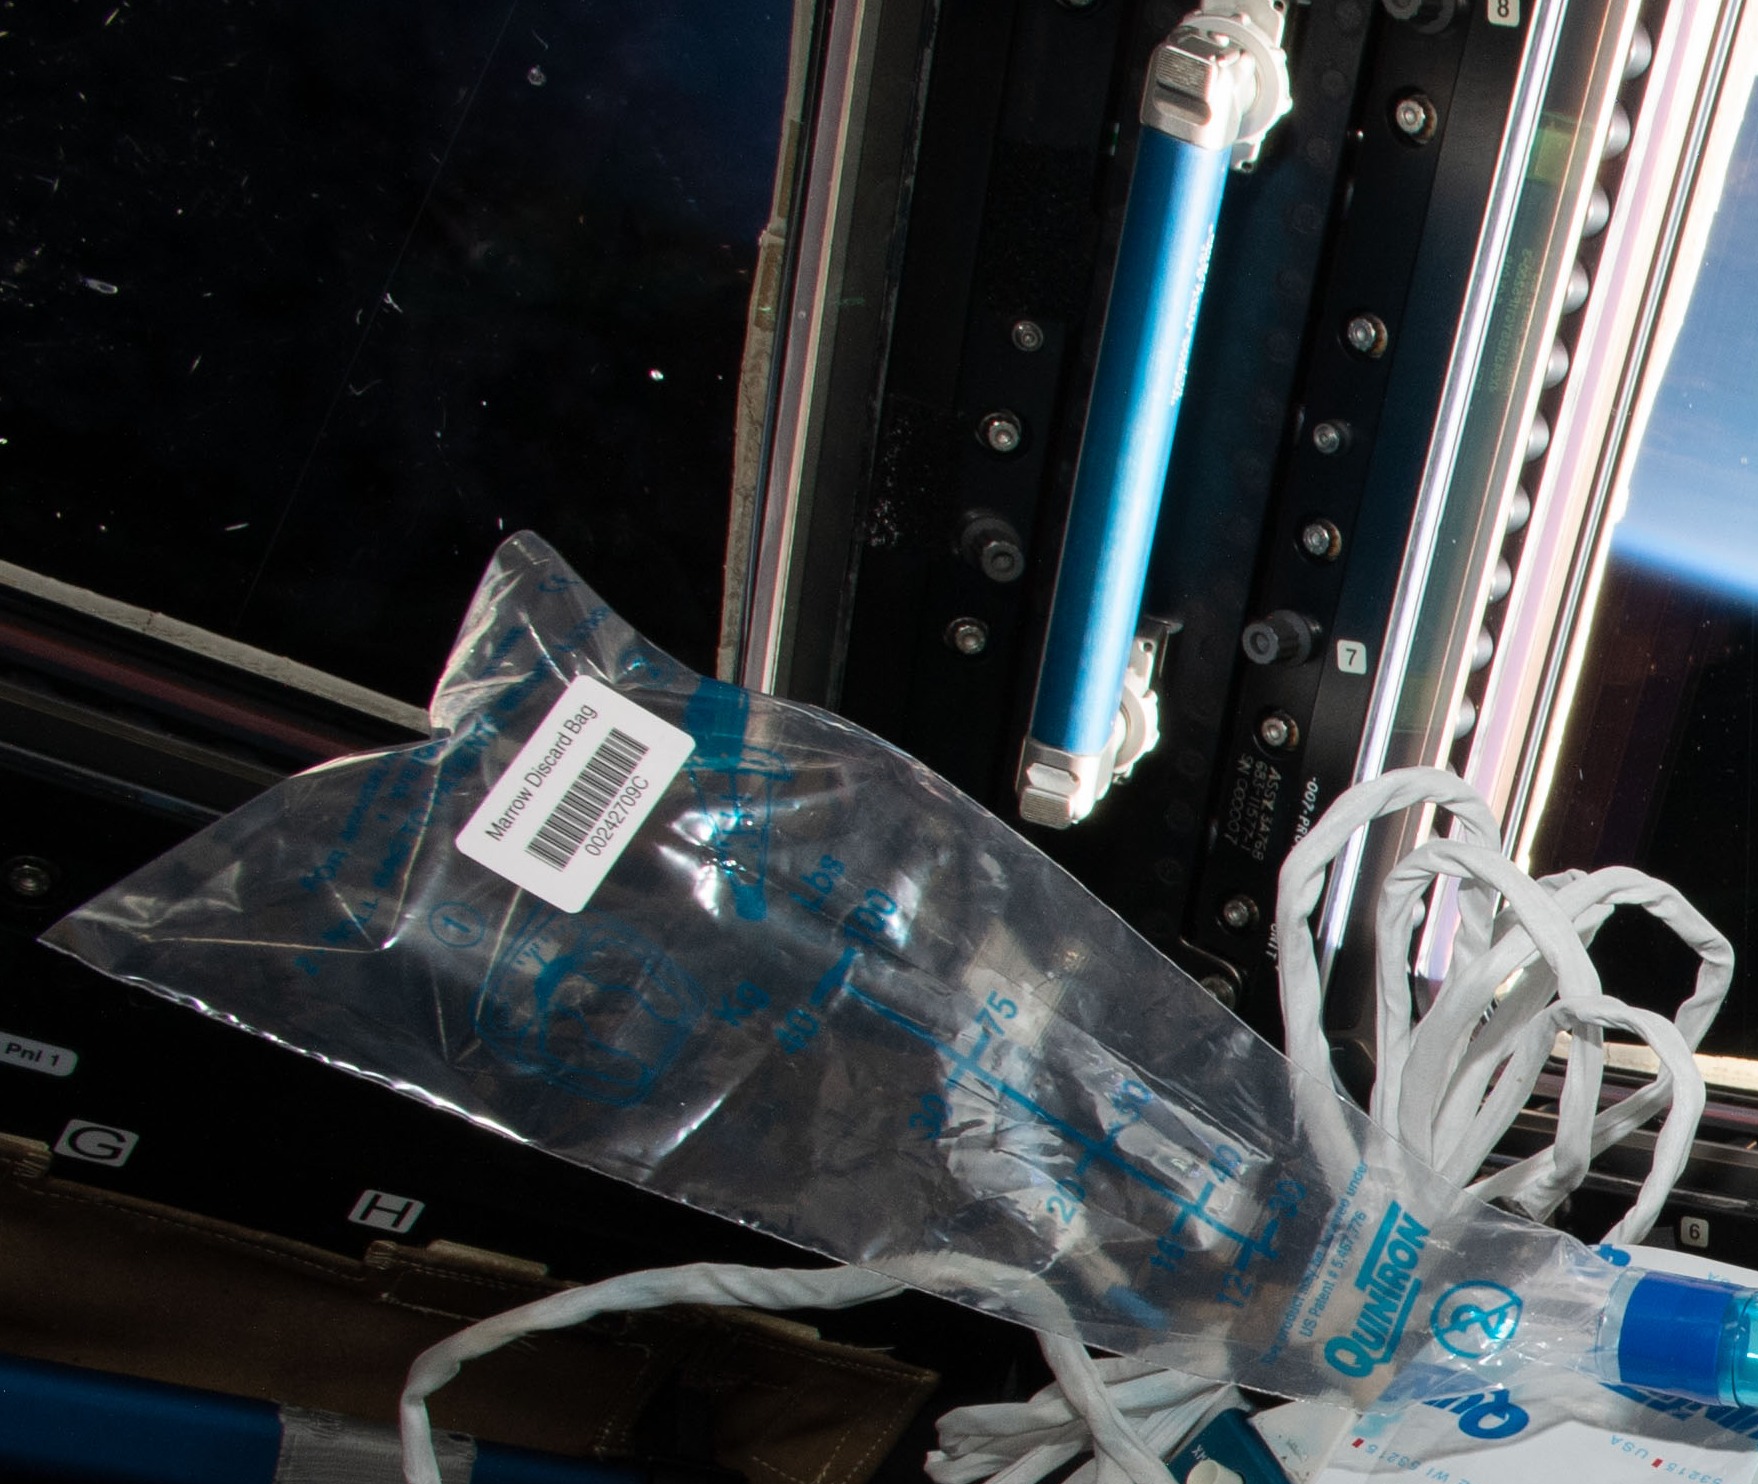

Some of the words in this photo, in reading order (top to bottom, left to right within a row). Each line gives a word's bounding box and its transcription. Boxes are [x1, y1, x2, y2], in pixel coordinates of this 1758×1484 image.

[1497, 0, 1509, 18] 8
[1345, 649, 1358, 667] 7
[485, 787, 534, 842] Marrow
[524, 732, 573, 788] Discard
[564, 704, 599, 735] Bag
[585, 775, 649, 857] 00242709C
[790, 854, 845, 912] Lbs
[712, 980, 772, 1028] Kg
[973, 990, 1020, 1038] 75
[774, 1008, 821, 1055] 40
[5, 1042, 43, 1064] Pnl
[51, 1051, 60, 1067] 1
[909, 1093, 953, 1140] 30
[69, 1126, 127, 1160] G
[1209, 1143, 1243, 1184] 40
[359, 1194, 414, 1229] H
[1045, 1178, 1087, 1225] 20
[1689, 1223, 1700, 1240] 6
[1216, 1272, 1254, 1309] 12
[1298, 1316, 1318, 1338] US
[1308, 1279, 1336, 1318] Patent
[1609, 1435, 1648, 1461] USA
